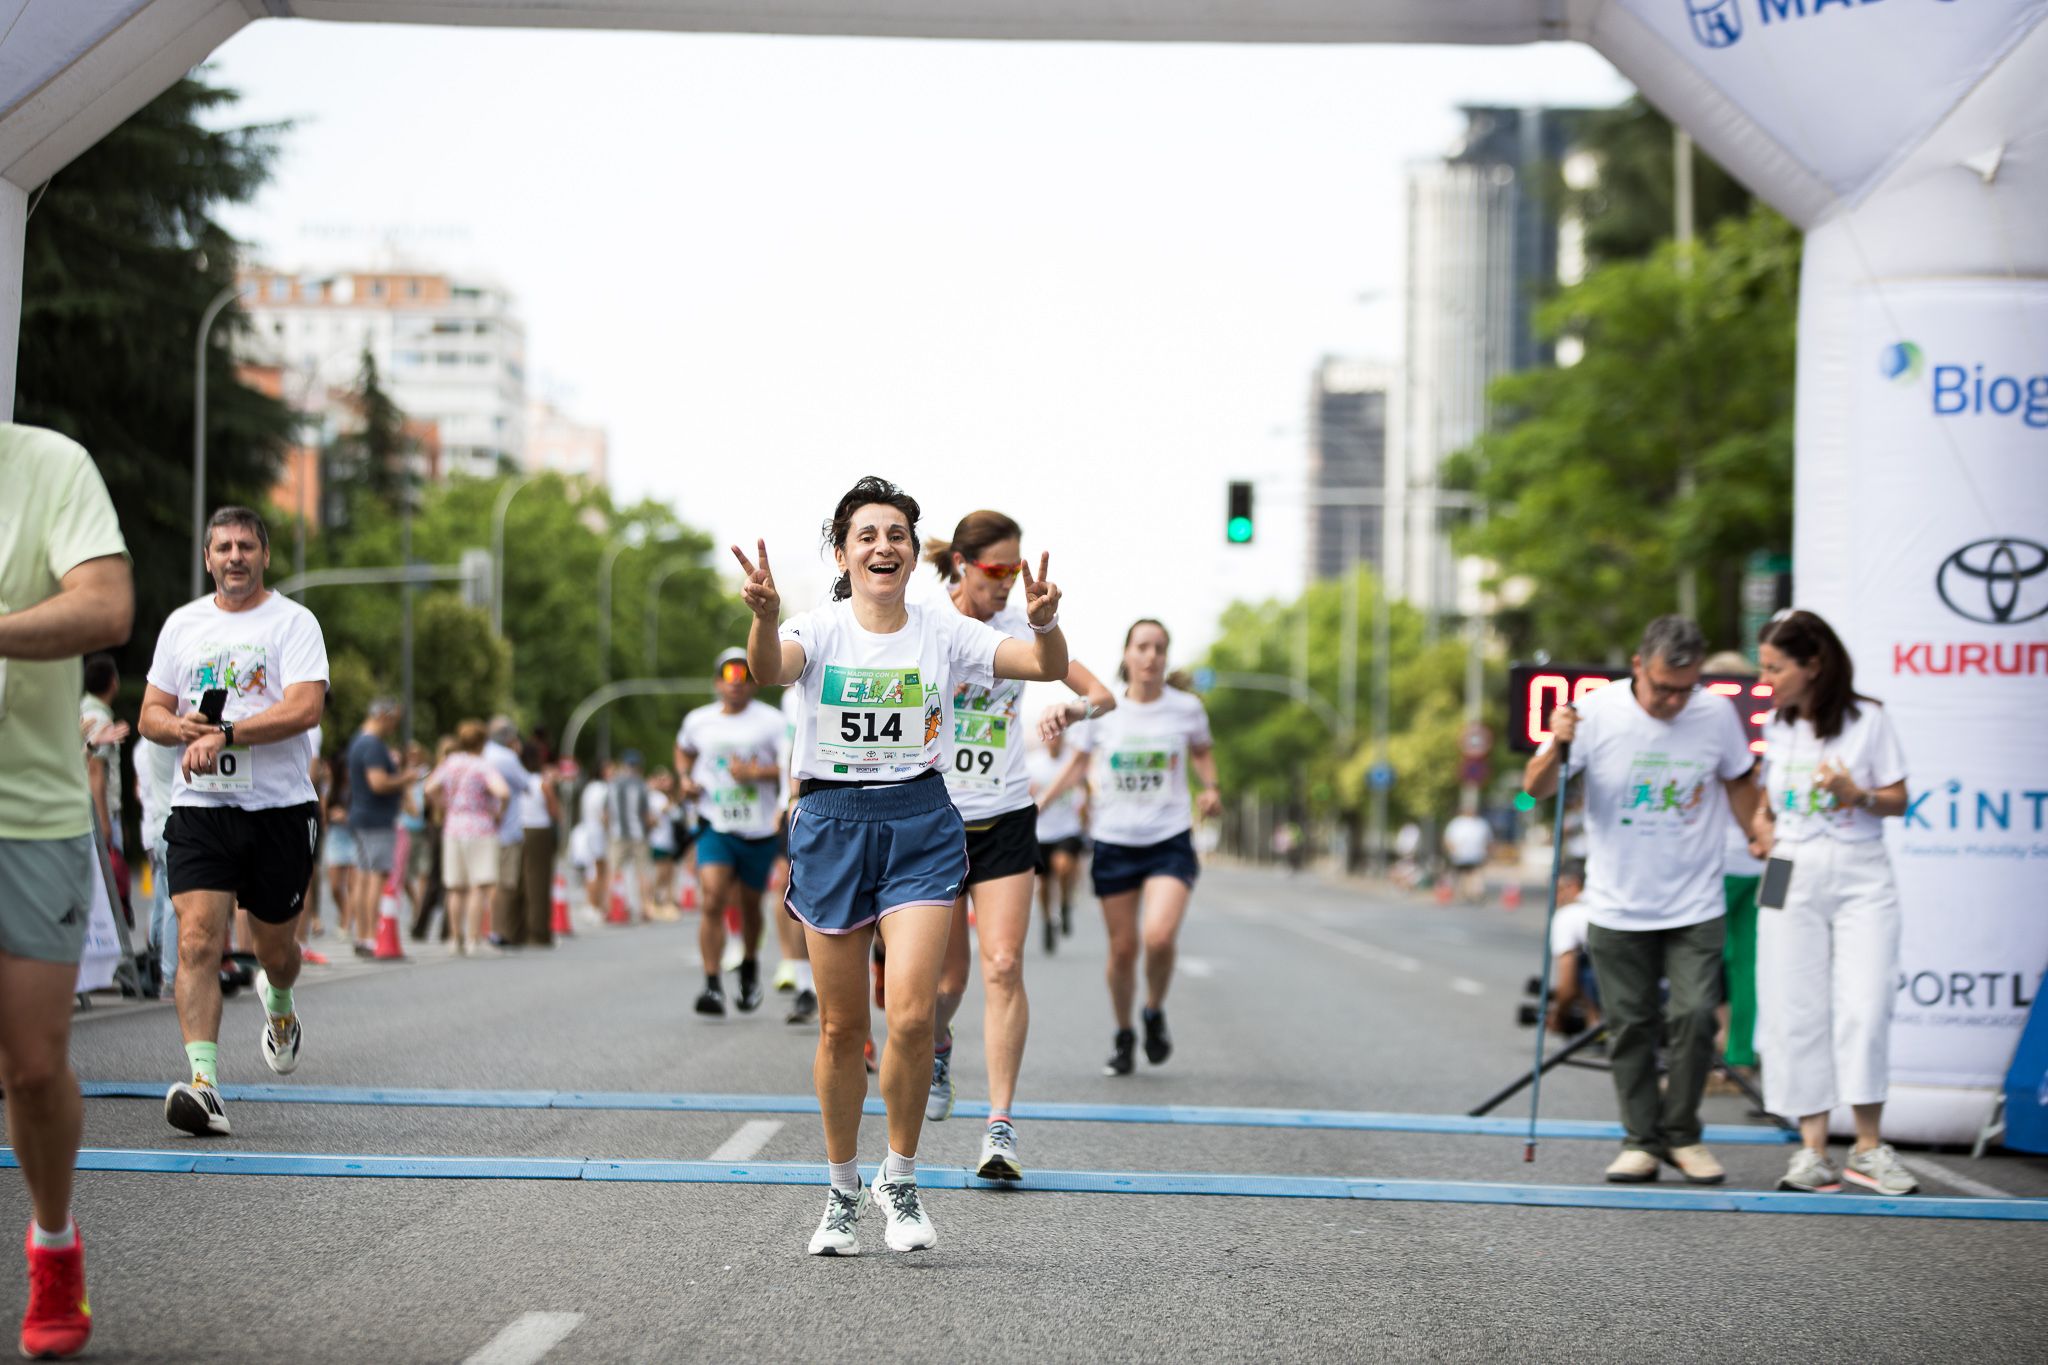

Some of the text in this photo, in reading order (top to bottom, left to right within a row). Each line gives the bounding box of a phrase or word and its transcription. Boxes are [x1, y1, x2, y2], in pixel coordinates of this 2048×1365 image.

[846, 670, 874, 678] MADRID
[840, 677, 903, 704] ELA
[841, 711, 903, 742] 514
[220, 753, 237, 777] 0
[955, 748, 994, 775] 09
